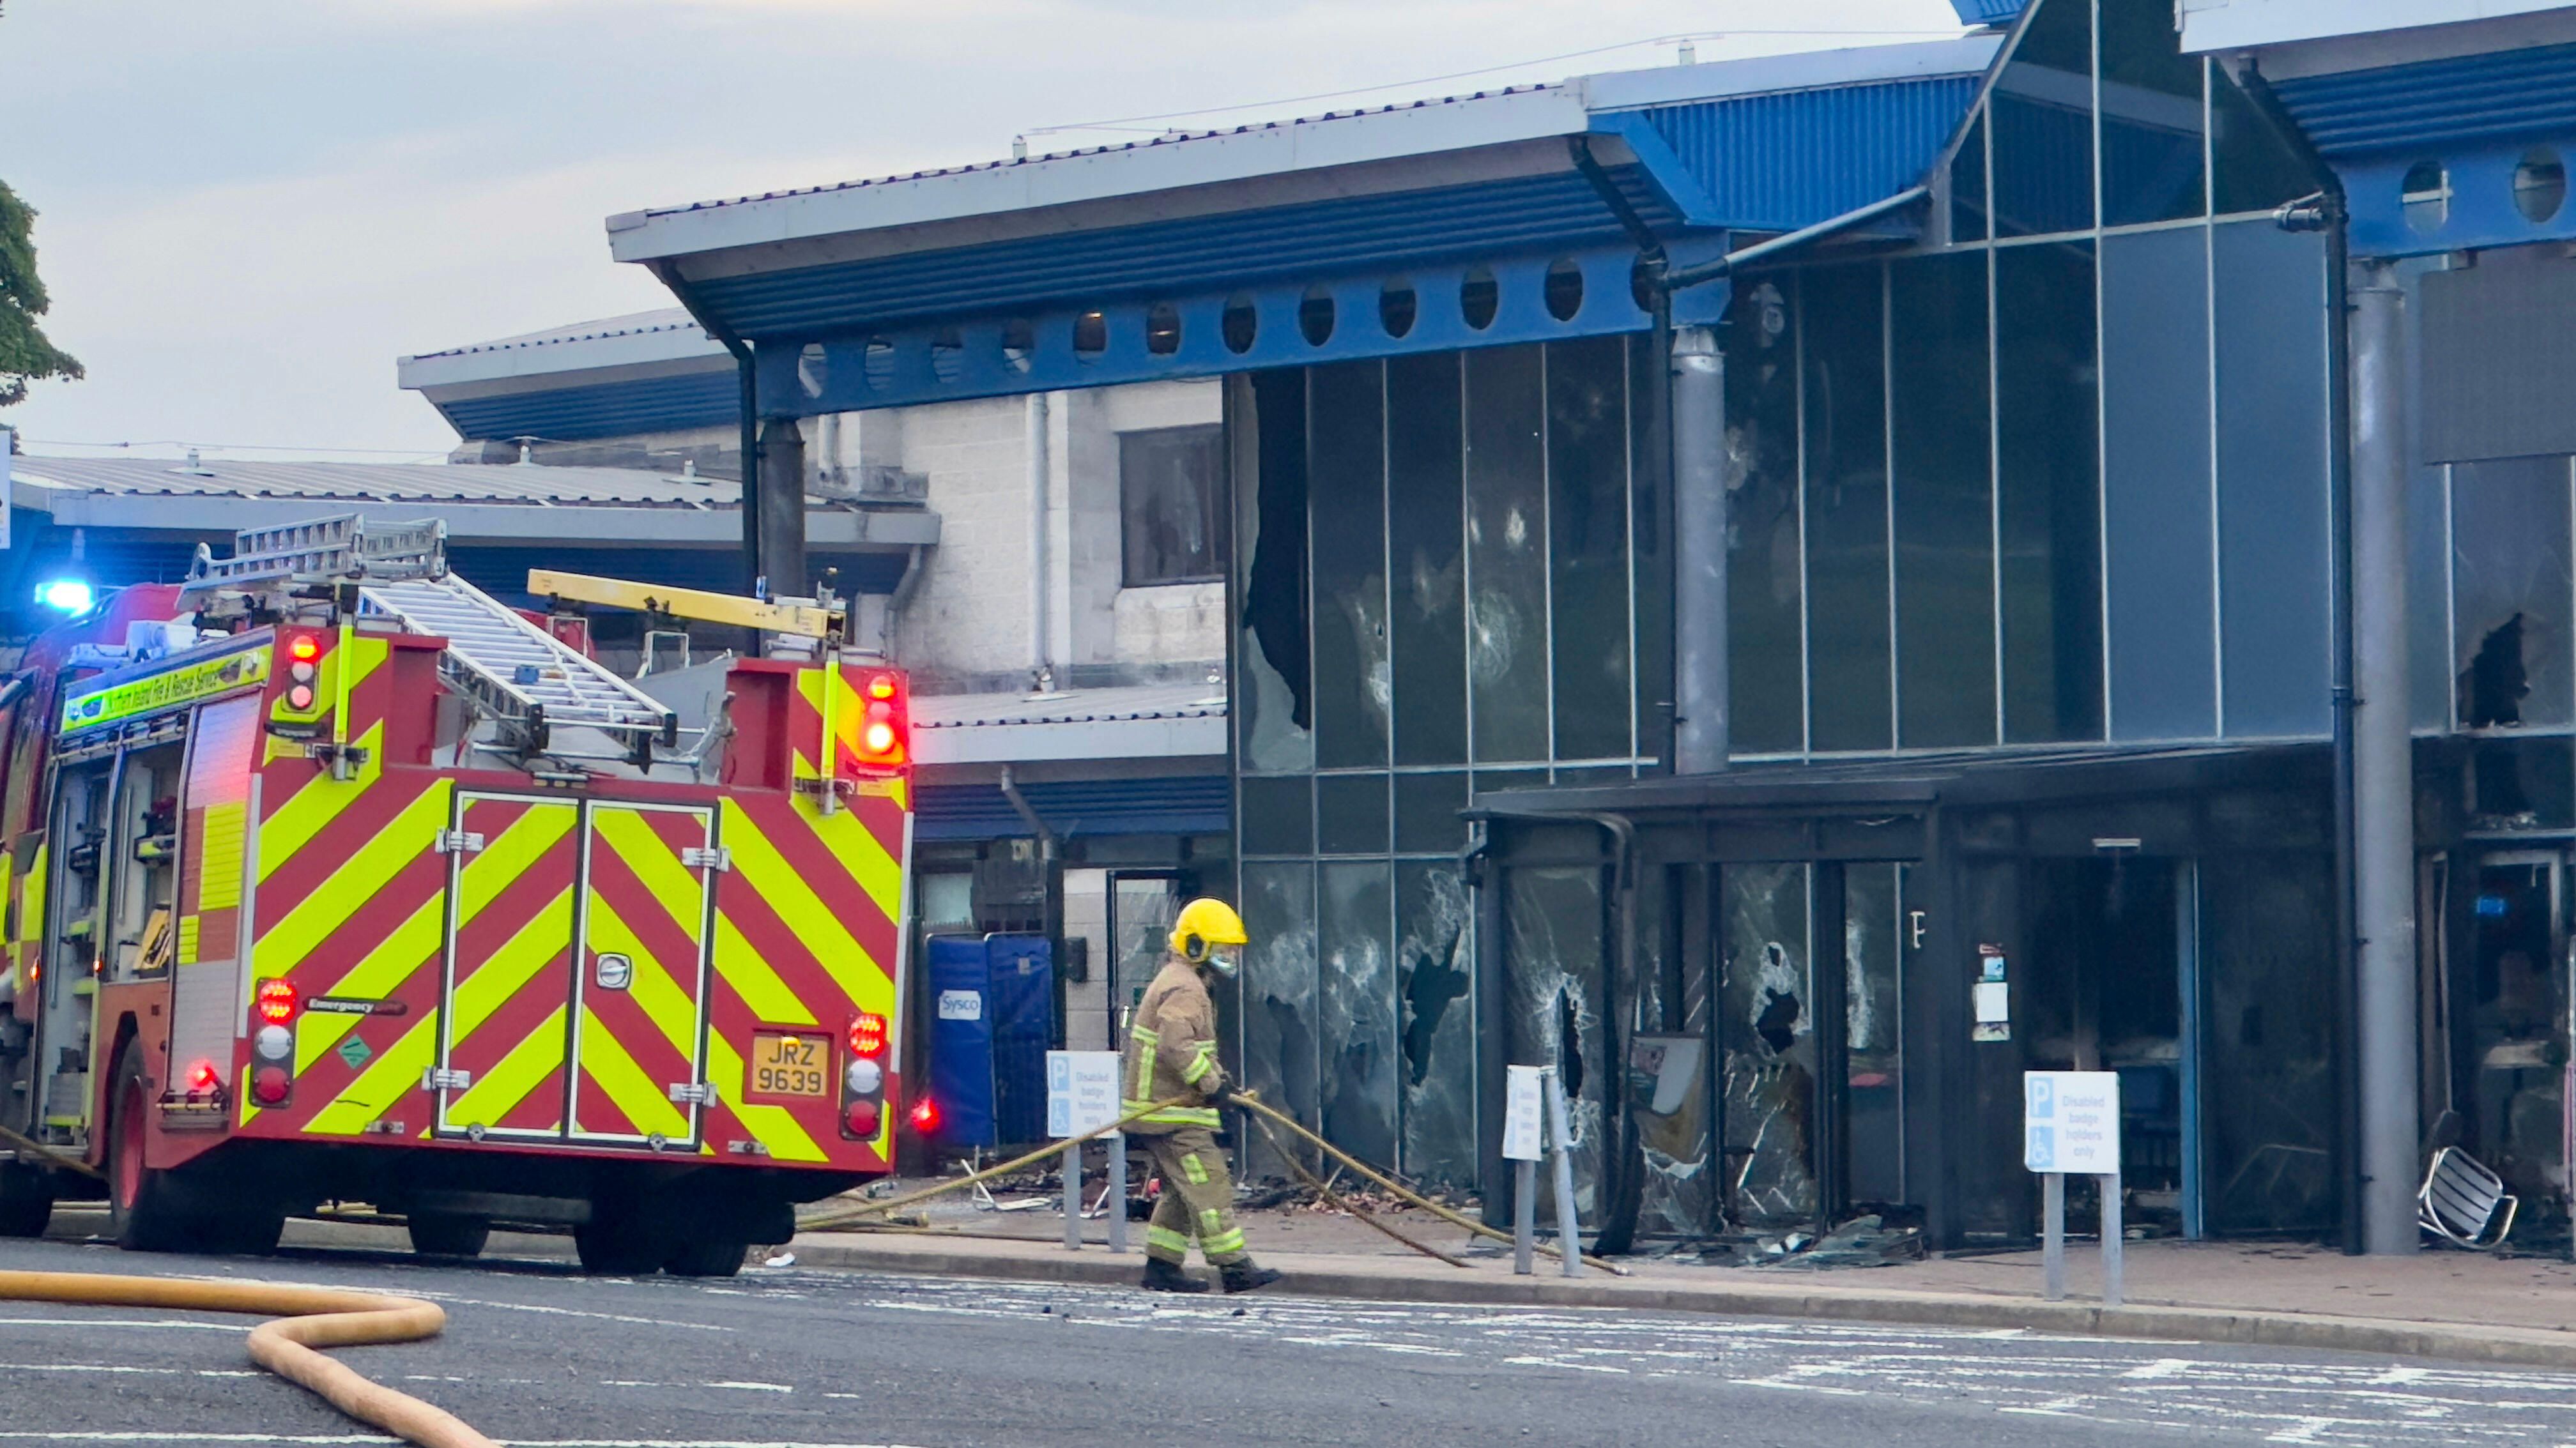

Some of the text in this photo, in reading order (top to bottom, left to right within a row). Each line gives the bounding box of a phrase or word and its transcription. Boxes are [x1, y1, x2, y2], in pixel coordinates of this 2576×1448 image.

[309, 998, 374, 1014] Emergency
[943, 996, 979, 1014] Sysco
[768, 1041, 815, 1065] JRZ
[758, 1067, 821, 1093] 9639
[1054, 1059, 1068, 1089] P
[2034, 1081, 2050, 1115] P
[2063, 1095, 2105, 1108] Disabled
[2068, 1112, 2099, 1126] badge
[2066, 1129, 2103, 1141] holders
[2074, 1146, 2096, 1159] only
